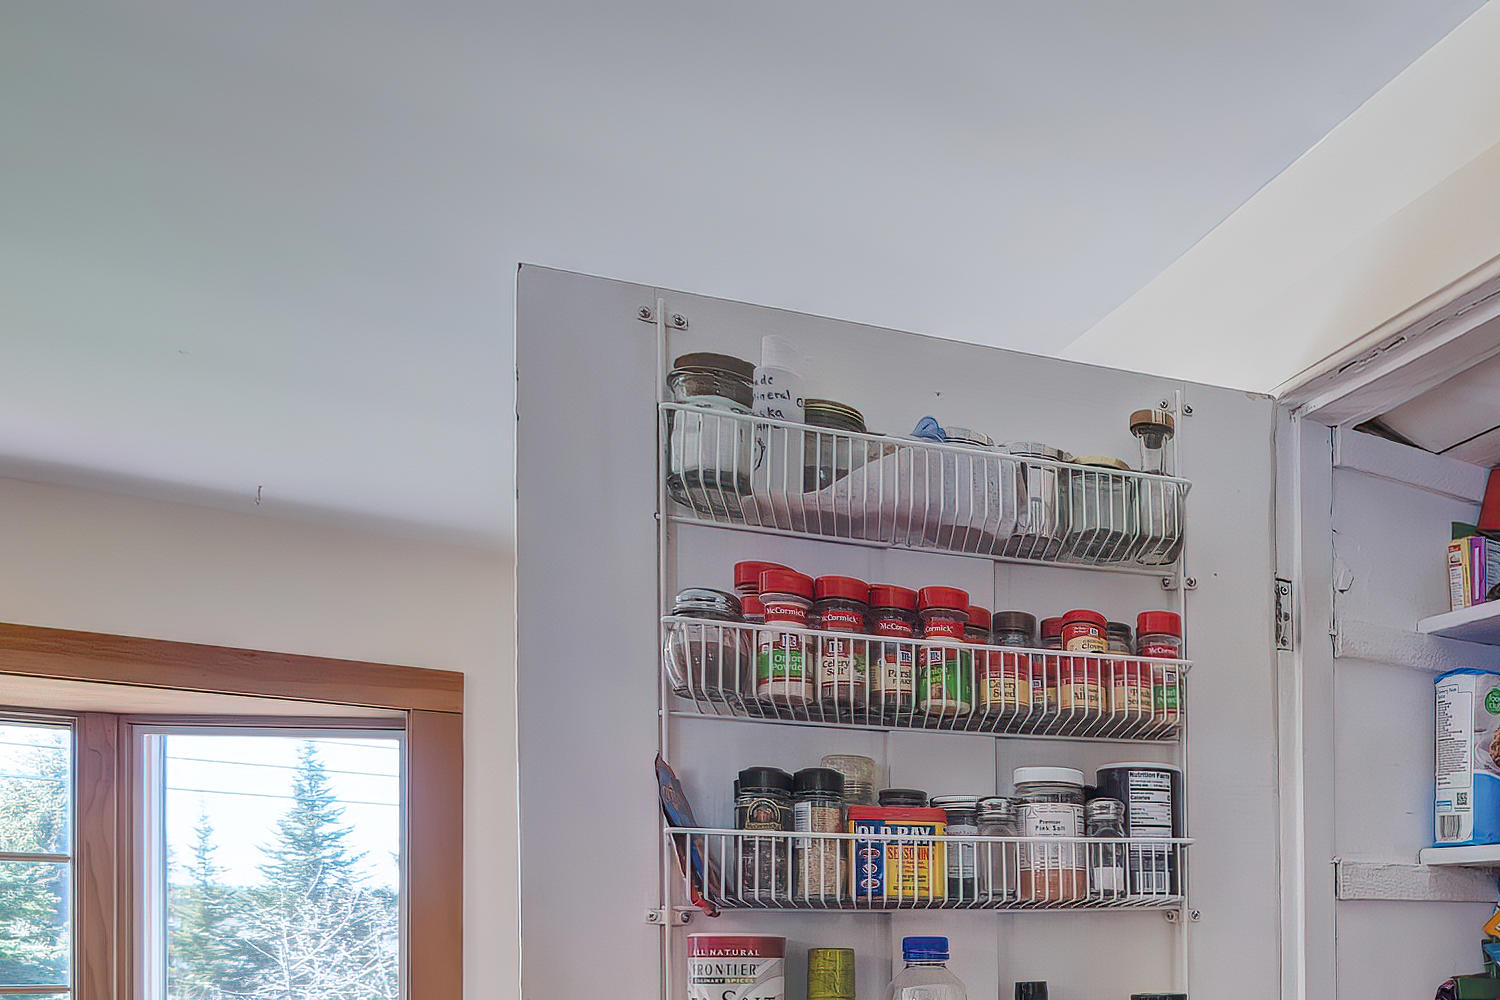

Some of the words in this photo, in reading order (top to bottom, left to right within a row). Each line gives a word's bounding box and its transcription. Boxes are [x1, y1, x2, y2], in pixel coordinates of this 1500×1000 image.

[767, 606, 805, 618] McCormick
[857, 825, 892, 843] OLD
[897, 825, 930, 845] BAY
